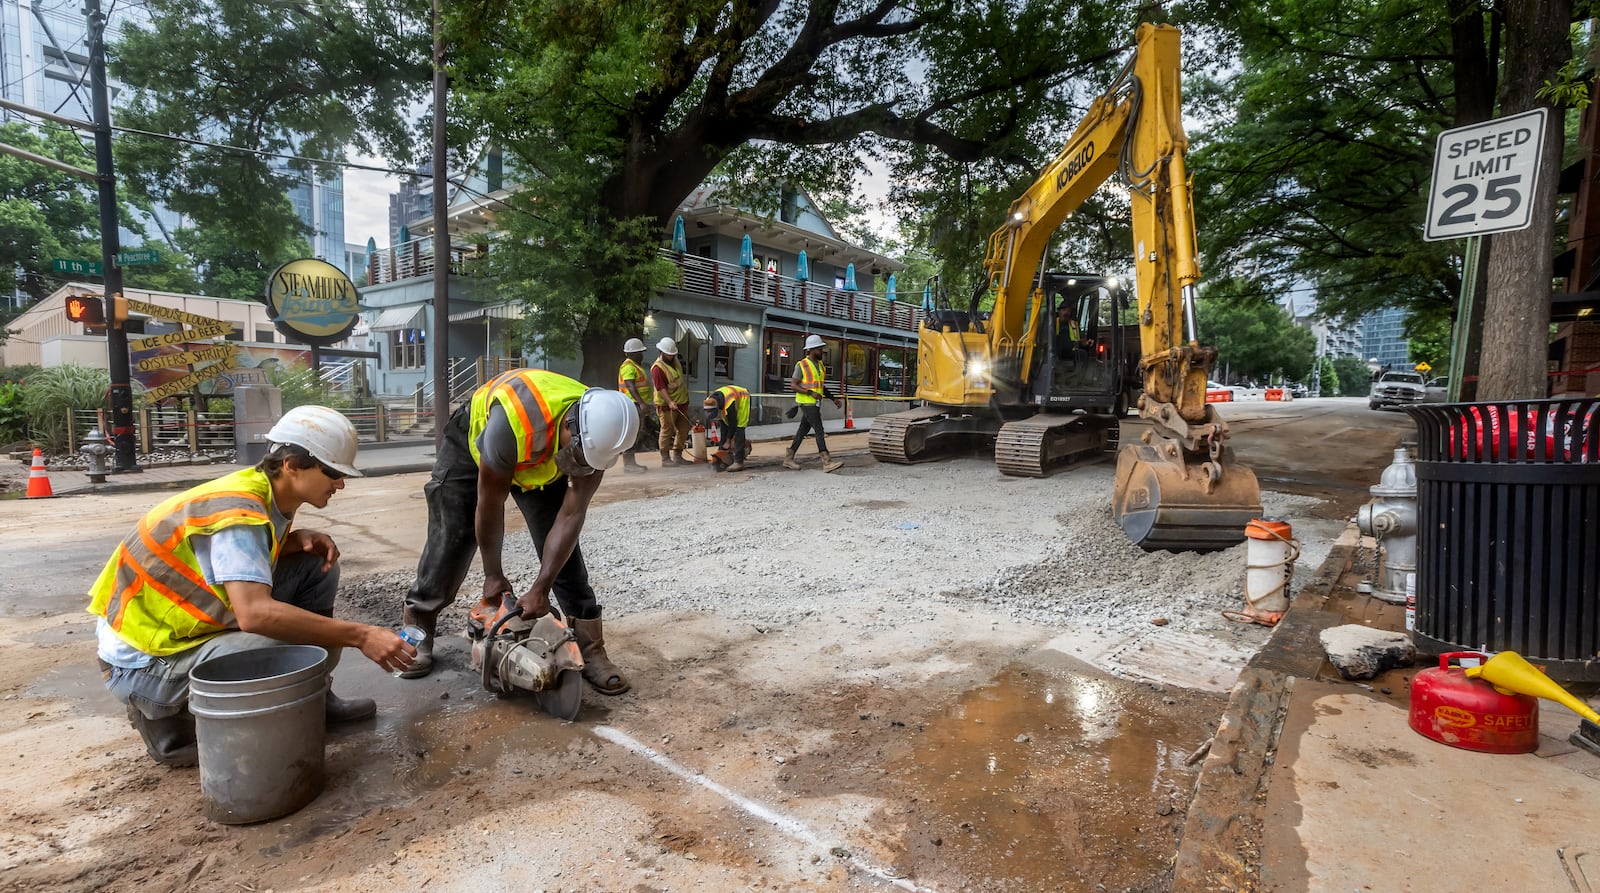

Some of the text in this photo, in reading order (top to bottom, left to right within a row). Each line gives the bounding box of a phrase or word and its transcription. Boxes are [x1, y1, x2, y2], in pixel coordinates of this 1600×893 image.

[1448, 128, 1531, 159] SPEED
[1056, 141, 1094, 192] KOBELCO
[1454, 153, 1517, 180] LIMIT
[1437, 174, 1522, 226] 25
[71, 261, 82, 271] th
[279, 271, 349, 301] STEAMHOUSE
[128, 300, 183, 321] STEAMHOUSE
[142, 325, 223, 348] ICE COLD BEER
[139, 346, 232, 371] OYSTERS SHRIMP
[150, 359, 233, 400] LOBSTER BISQUE
